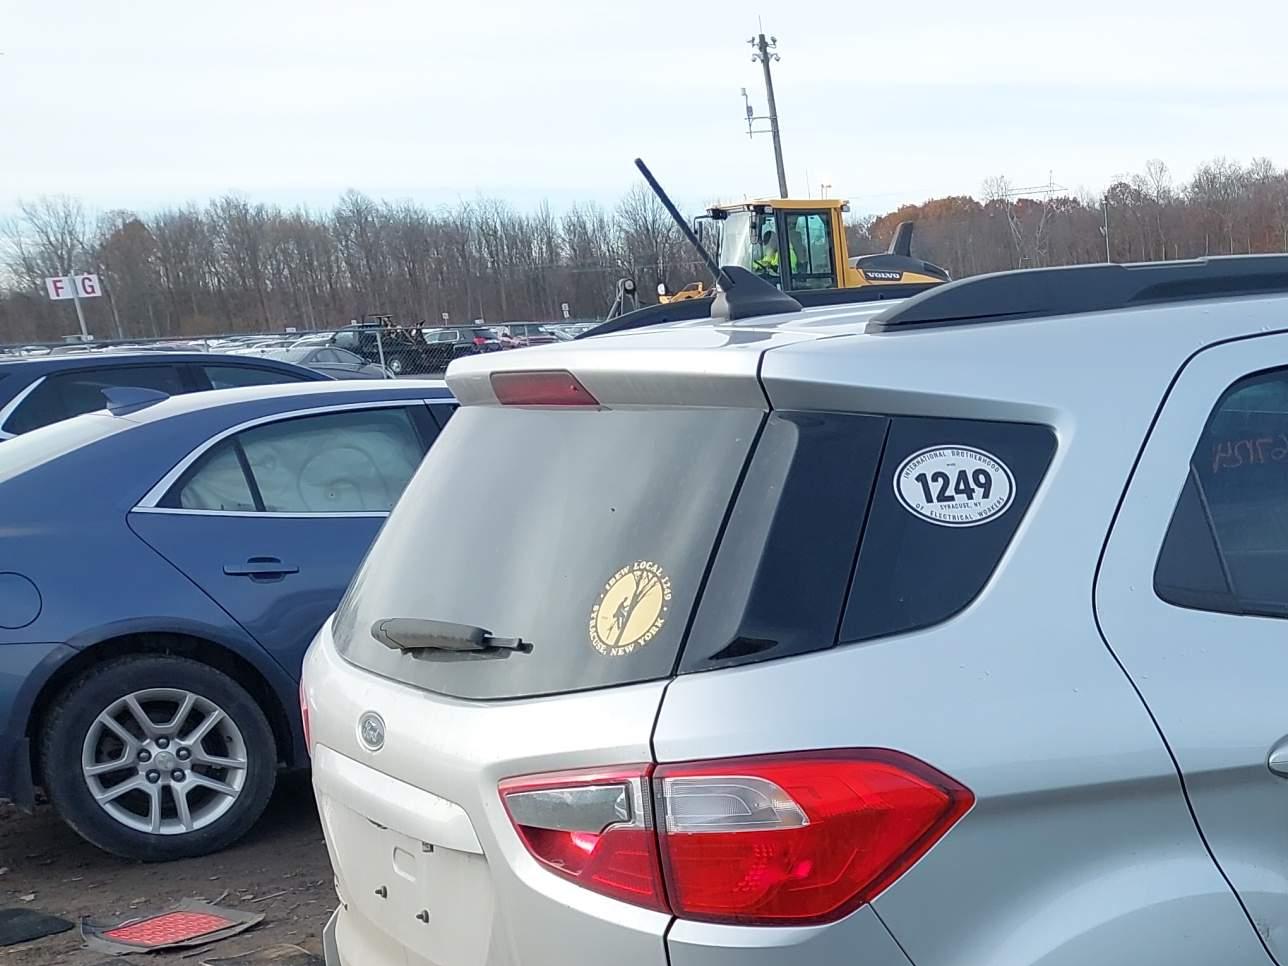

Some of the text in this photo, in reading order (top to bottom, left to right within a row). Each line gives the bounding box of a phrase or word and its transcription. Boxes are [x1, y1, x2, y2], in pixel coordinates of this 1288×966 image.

[52, 277, 96, 297] F G
[866, 271, 901, 279] VOLVO
[904, 450, 1000, 479] INTERNATIONAL BROTHERHOOD
[915, 468, 993, 504] 1249
[915, 496, 1005, 521] OF ELECTRICAL WORKERS
[605, 560, 672, 600] IBEW LOCAL 1249
[610, 643, 636, 656] NEW
[637, 617, 664, 646] YORK
